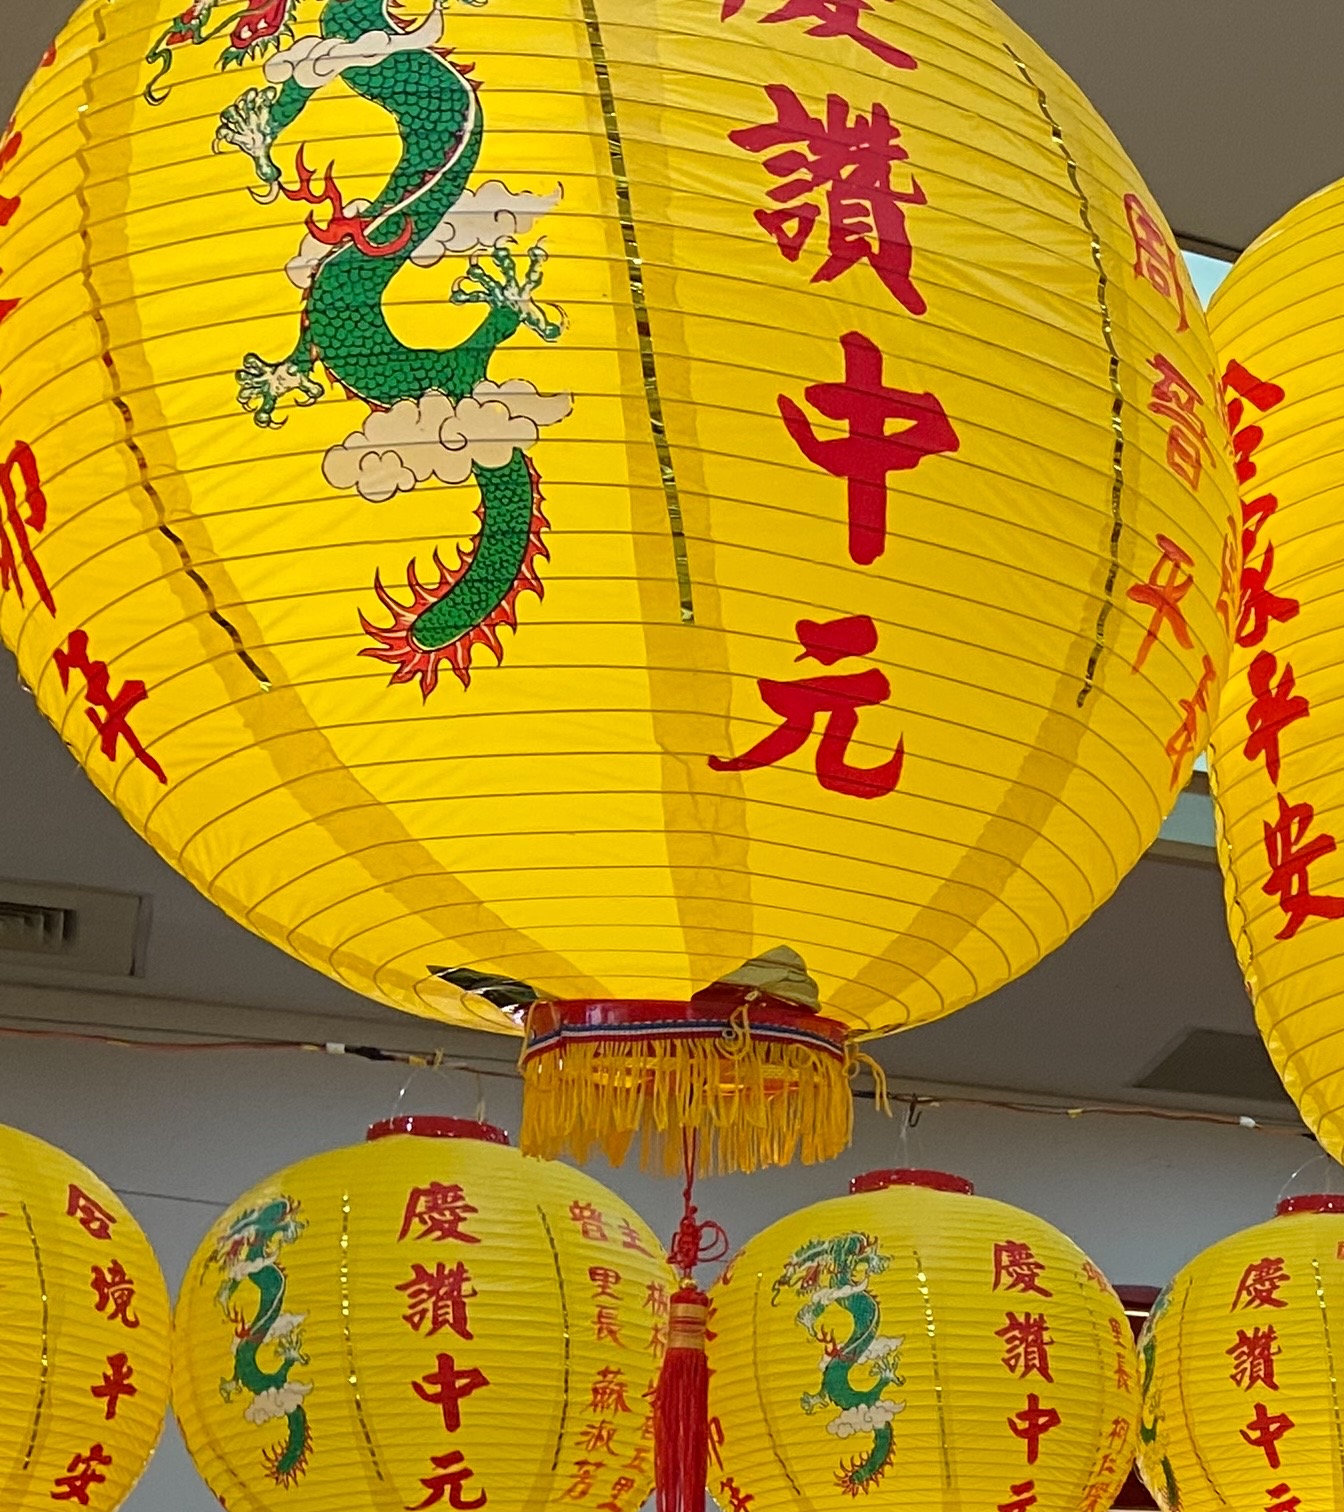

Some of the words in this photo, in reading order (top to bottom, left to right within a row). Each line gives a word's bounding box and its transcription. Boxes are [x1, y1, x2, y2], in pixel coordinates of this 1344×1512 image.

[708, 0, 960, 800] 讚中元
[50, 1182, 141, 1507] 合境平安
